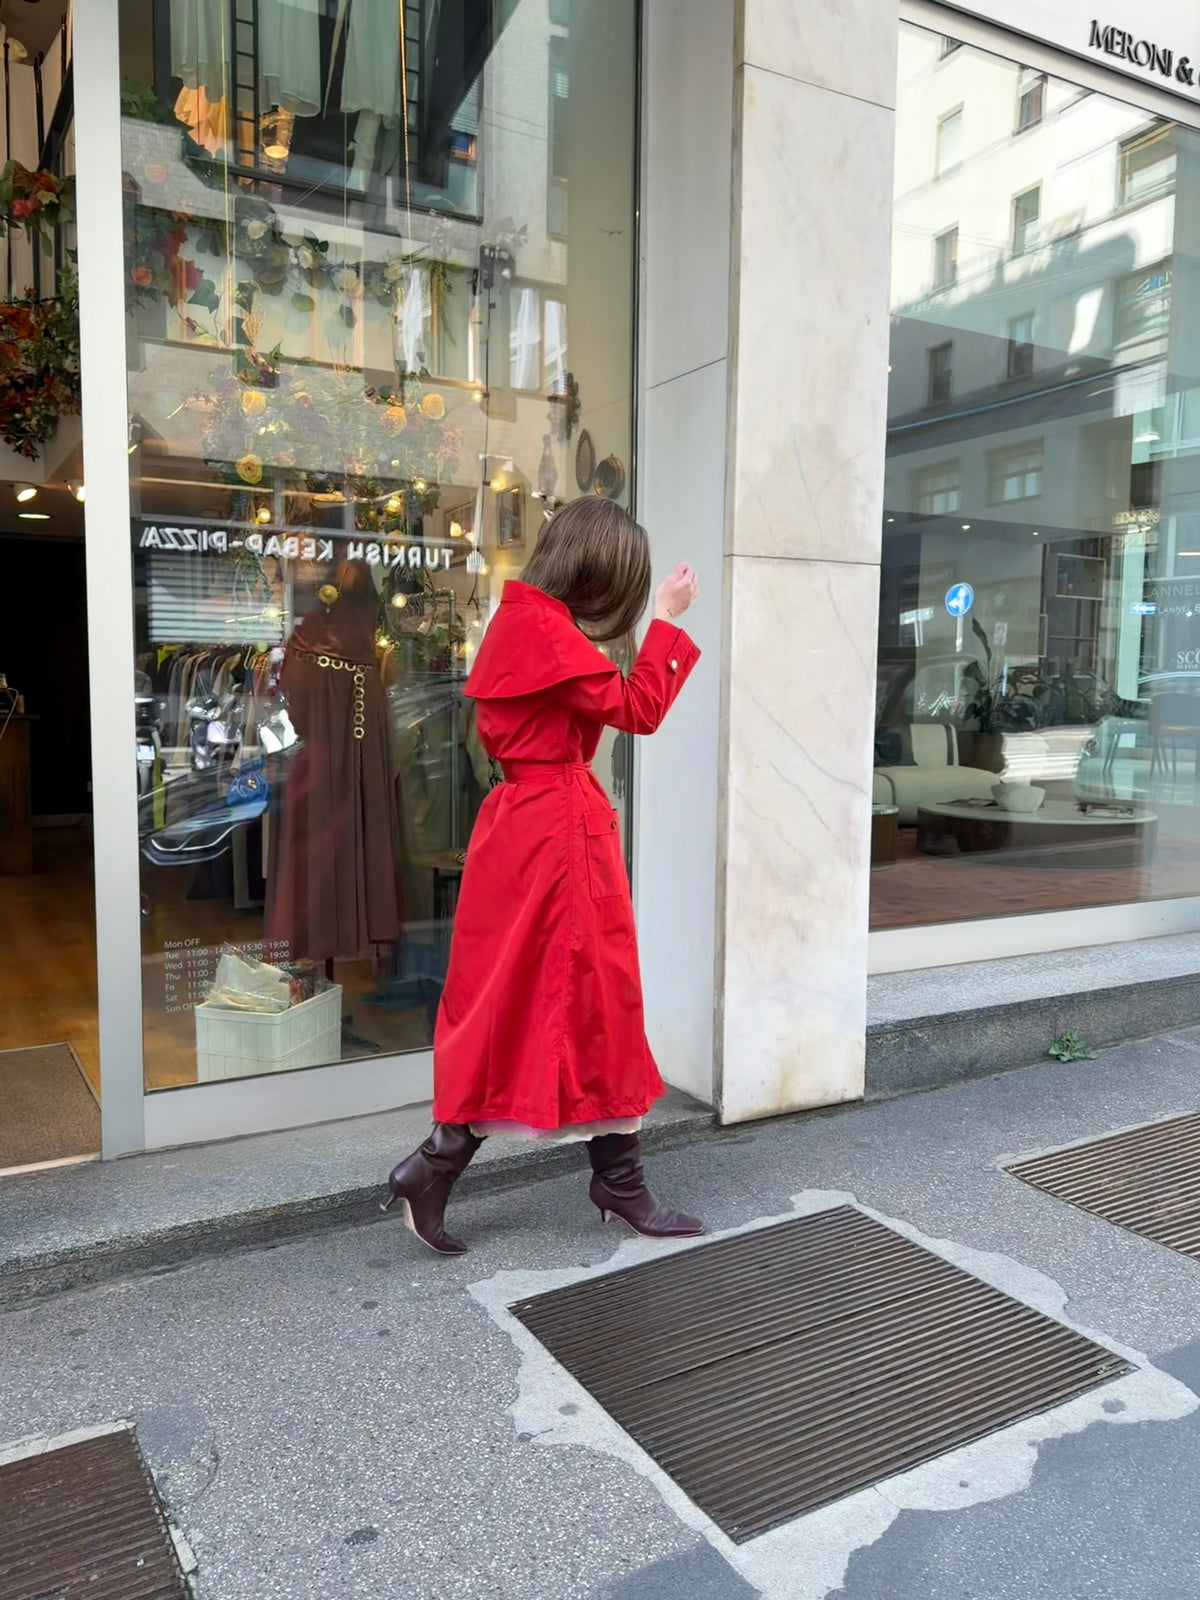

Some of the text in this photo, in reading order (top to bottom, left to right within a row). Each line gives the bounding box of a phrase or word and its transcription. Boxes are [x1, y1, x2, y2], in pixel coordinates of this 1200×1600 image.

[1088, 19, 1174, 77] MERONI
[1175, 56, 1196, 86] &
[164, 938, 201, 949] Mon OFF
[165, 951, 180, 959] Tue
[187, 948, 208, 957] 11:00
[242, 942, 263, 951] 15:30
[269, 940, 290, 949] 19:00
[164, 962, 183, 970] Wed
[187, 959, 209, 968] 11:00
[269, 950, 290, 959] 19:00
[165, 972, 181, 981] Thu
[187, 969, 209, 978] 11:00
[165, 980, 209, 992] Fri 11:00
[165, 994, 179, 1002] Sat
[165, 1005, 181, 1013] Sun
